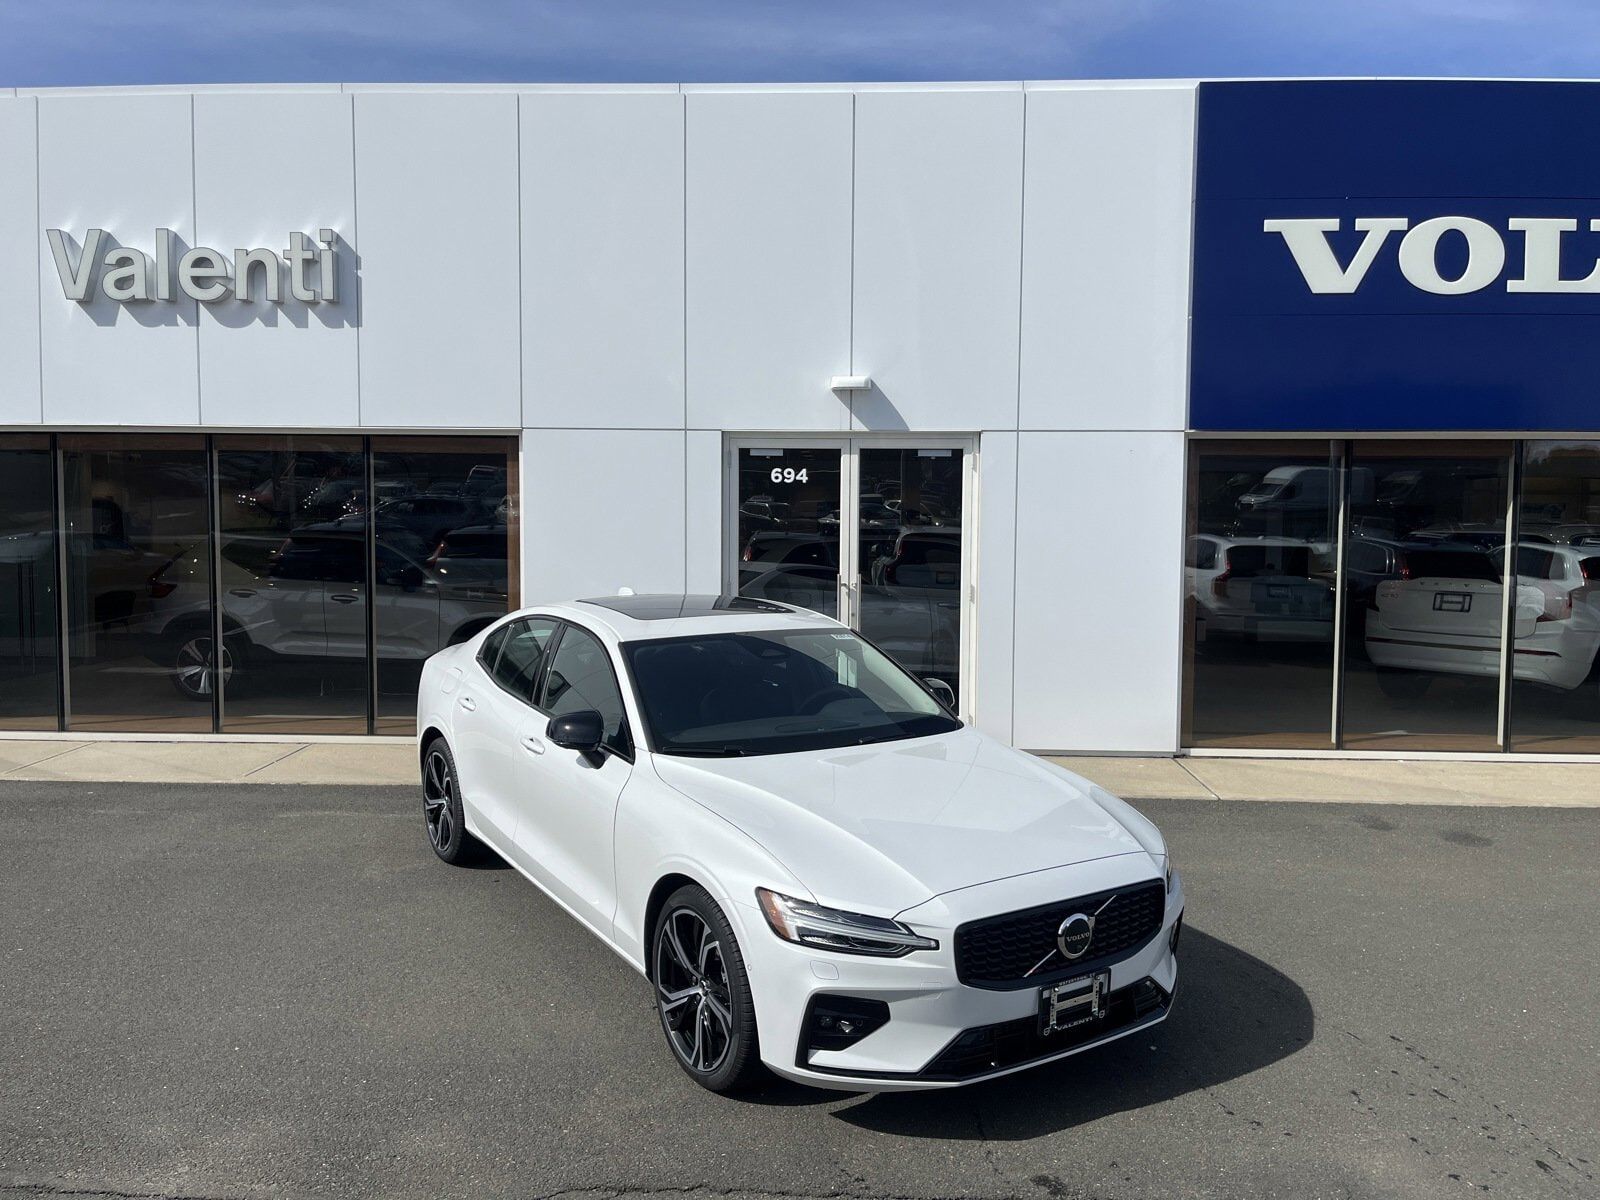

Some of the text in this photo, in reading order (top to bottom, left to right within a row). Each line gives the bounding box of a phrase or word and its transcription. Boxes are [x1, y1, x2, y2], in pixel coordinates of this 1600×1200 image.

[1263, 216, 1600, 295] VOL
[46, 228, 339, 303] Valenti
[770, 468, 808, 484] 694
[1066, 931, 1090, 942] VOLVO
[1056, 1016, 1093, 1031] VALENTI
